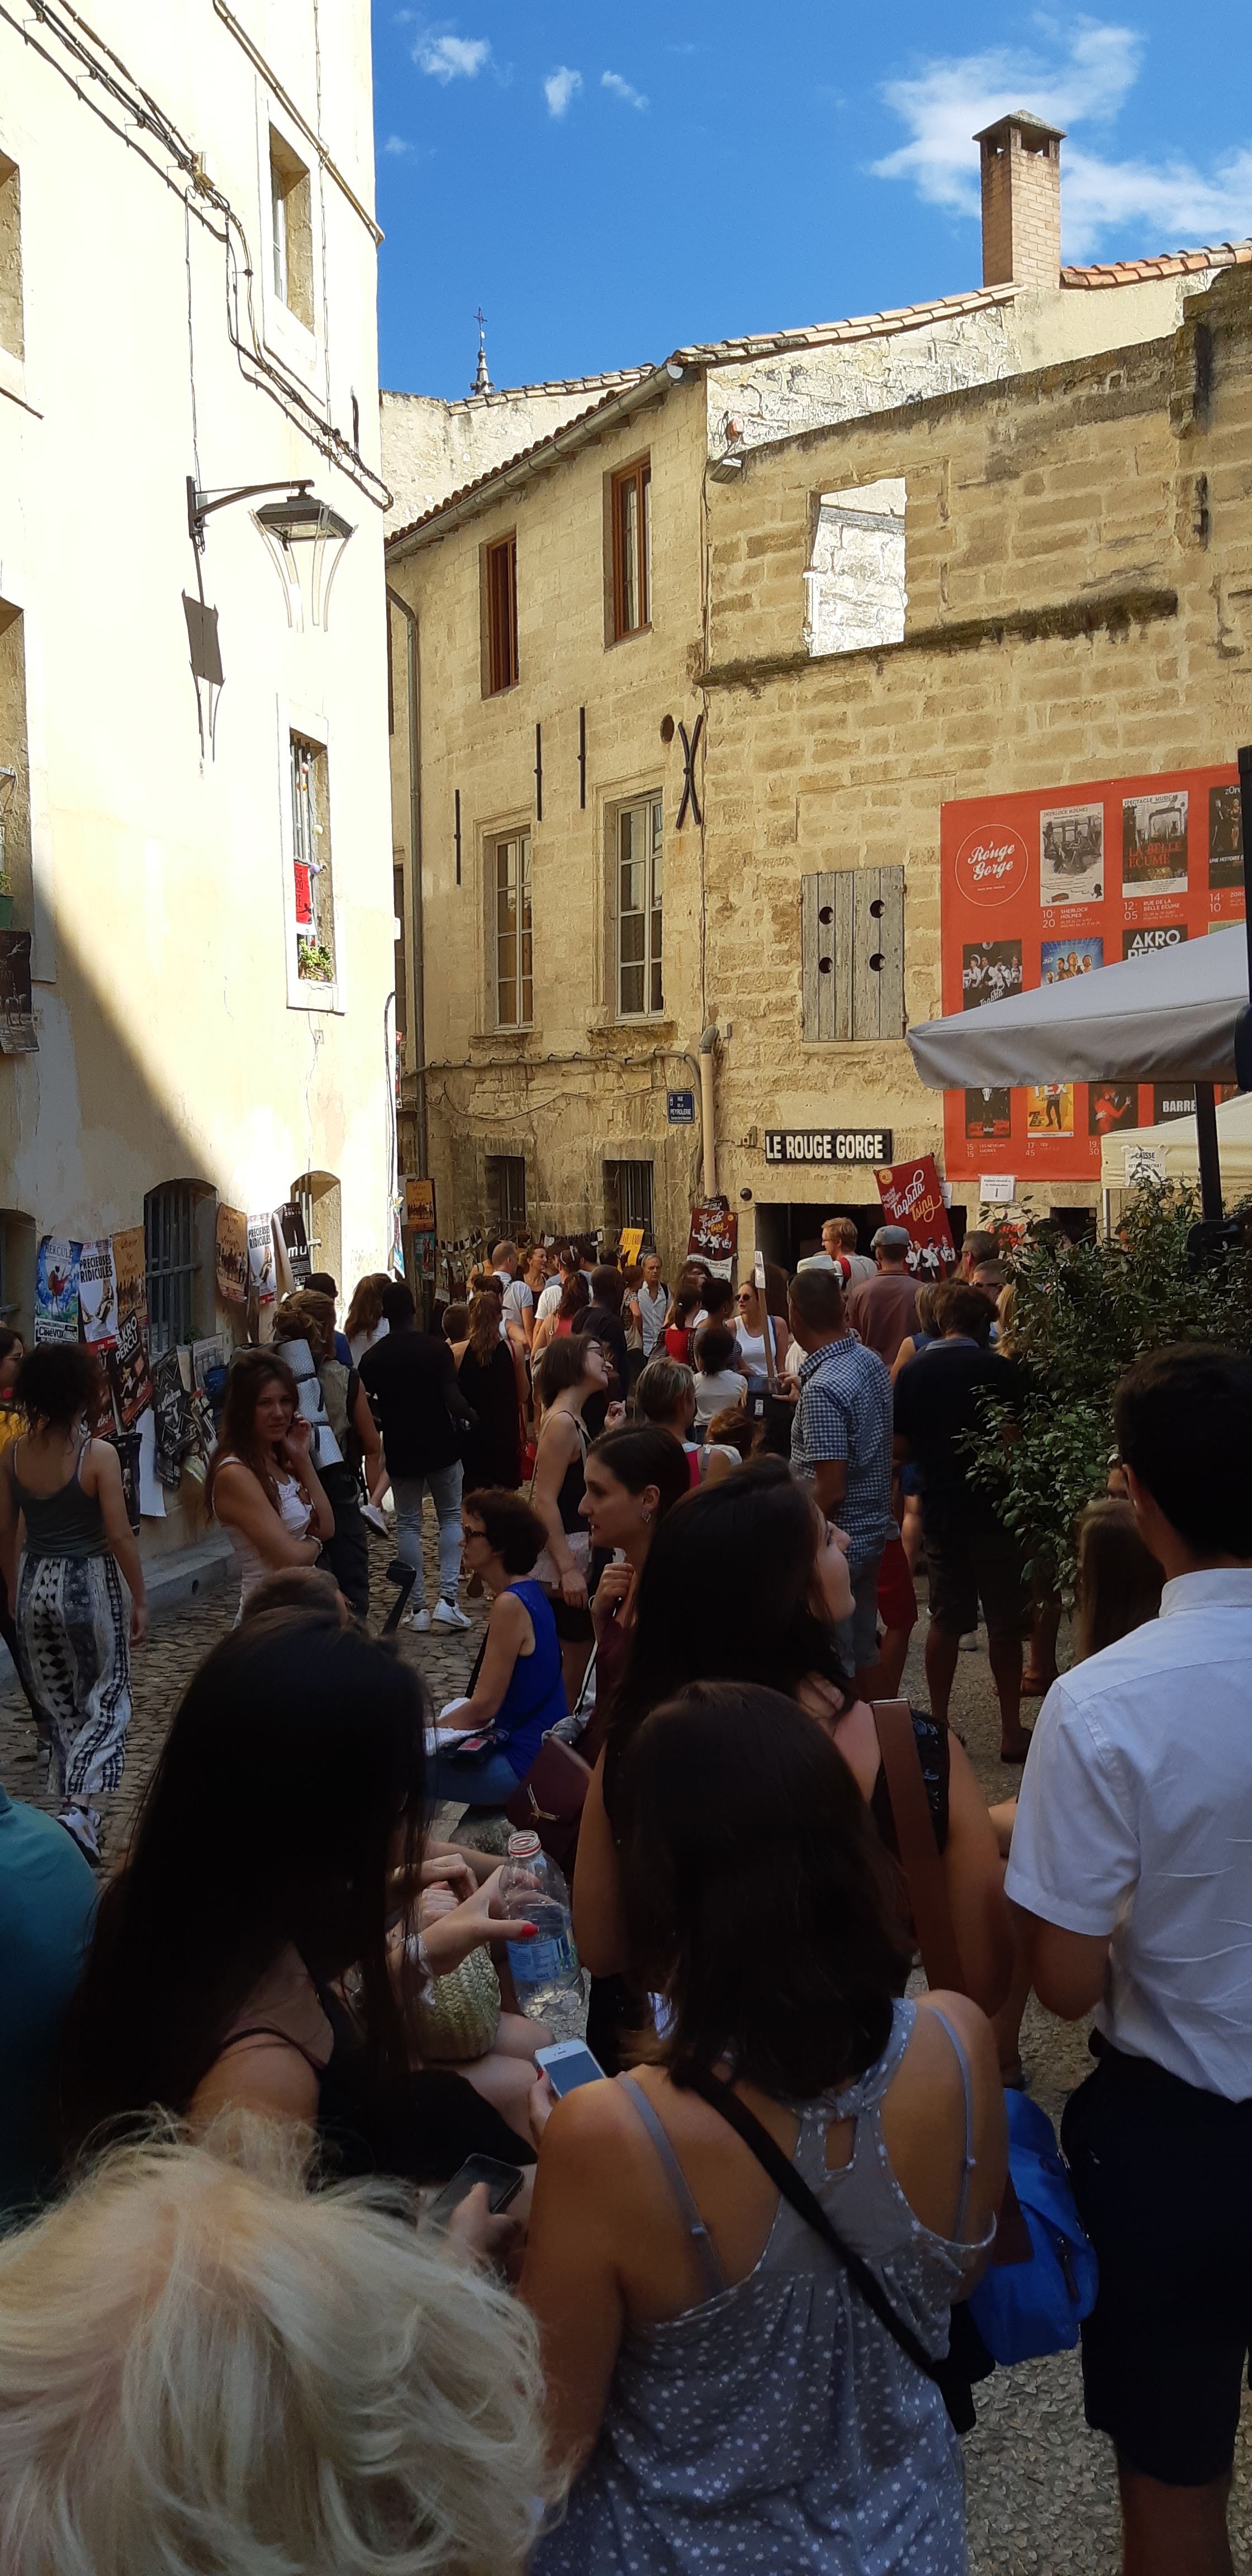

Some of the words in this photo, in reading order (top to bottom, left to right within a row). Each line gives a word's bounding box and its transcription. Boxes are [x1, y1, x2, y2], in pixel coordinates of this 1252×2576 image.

[968, 842, 1015, 864] Rouge
[1129, 854, 1170, 868] ECUME
[973, 860, 1014, 880] Gorge
[1124, 911, 1138, 920] 05
[1210, 903, 1221, 913] 10
[1042, 919, 1055, 929] 20
[1132, 929, 1180, 949] AKRO
[1031, 1083, 1068, 1097] TEX
[766, 1135, 782, 1159] LE
[786, 1135, 832, 1159] ROUGE
[836, 1135, 883, 1159] GORGE
[248, 1225, 270, 1238] PRECIEUSES
[249, 1234, 271, 1249] RIDICULES
[45, 1243, 74, 1258] HERCULE
[80, 1254, 112, 1271] PRECIEUSES
[80, 1266, 113, 1284] RIDICULES
[121, 1315, 137, 1343] KRO
[116, 1329, 137, 1365] PERCU
